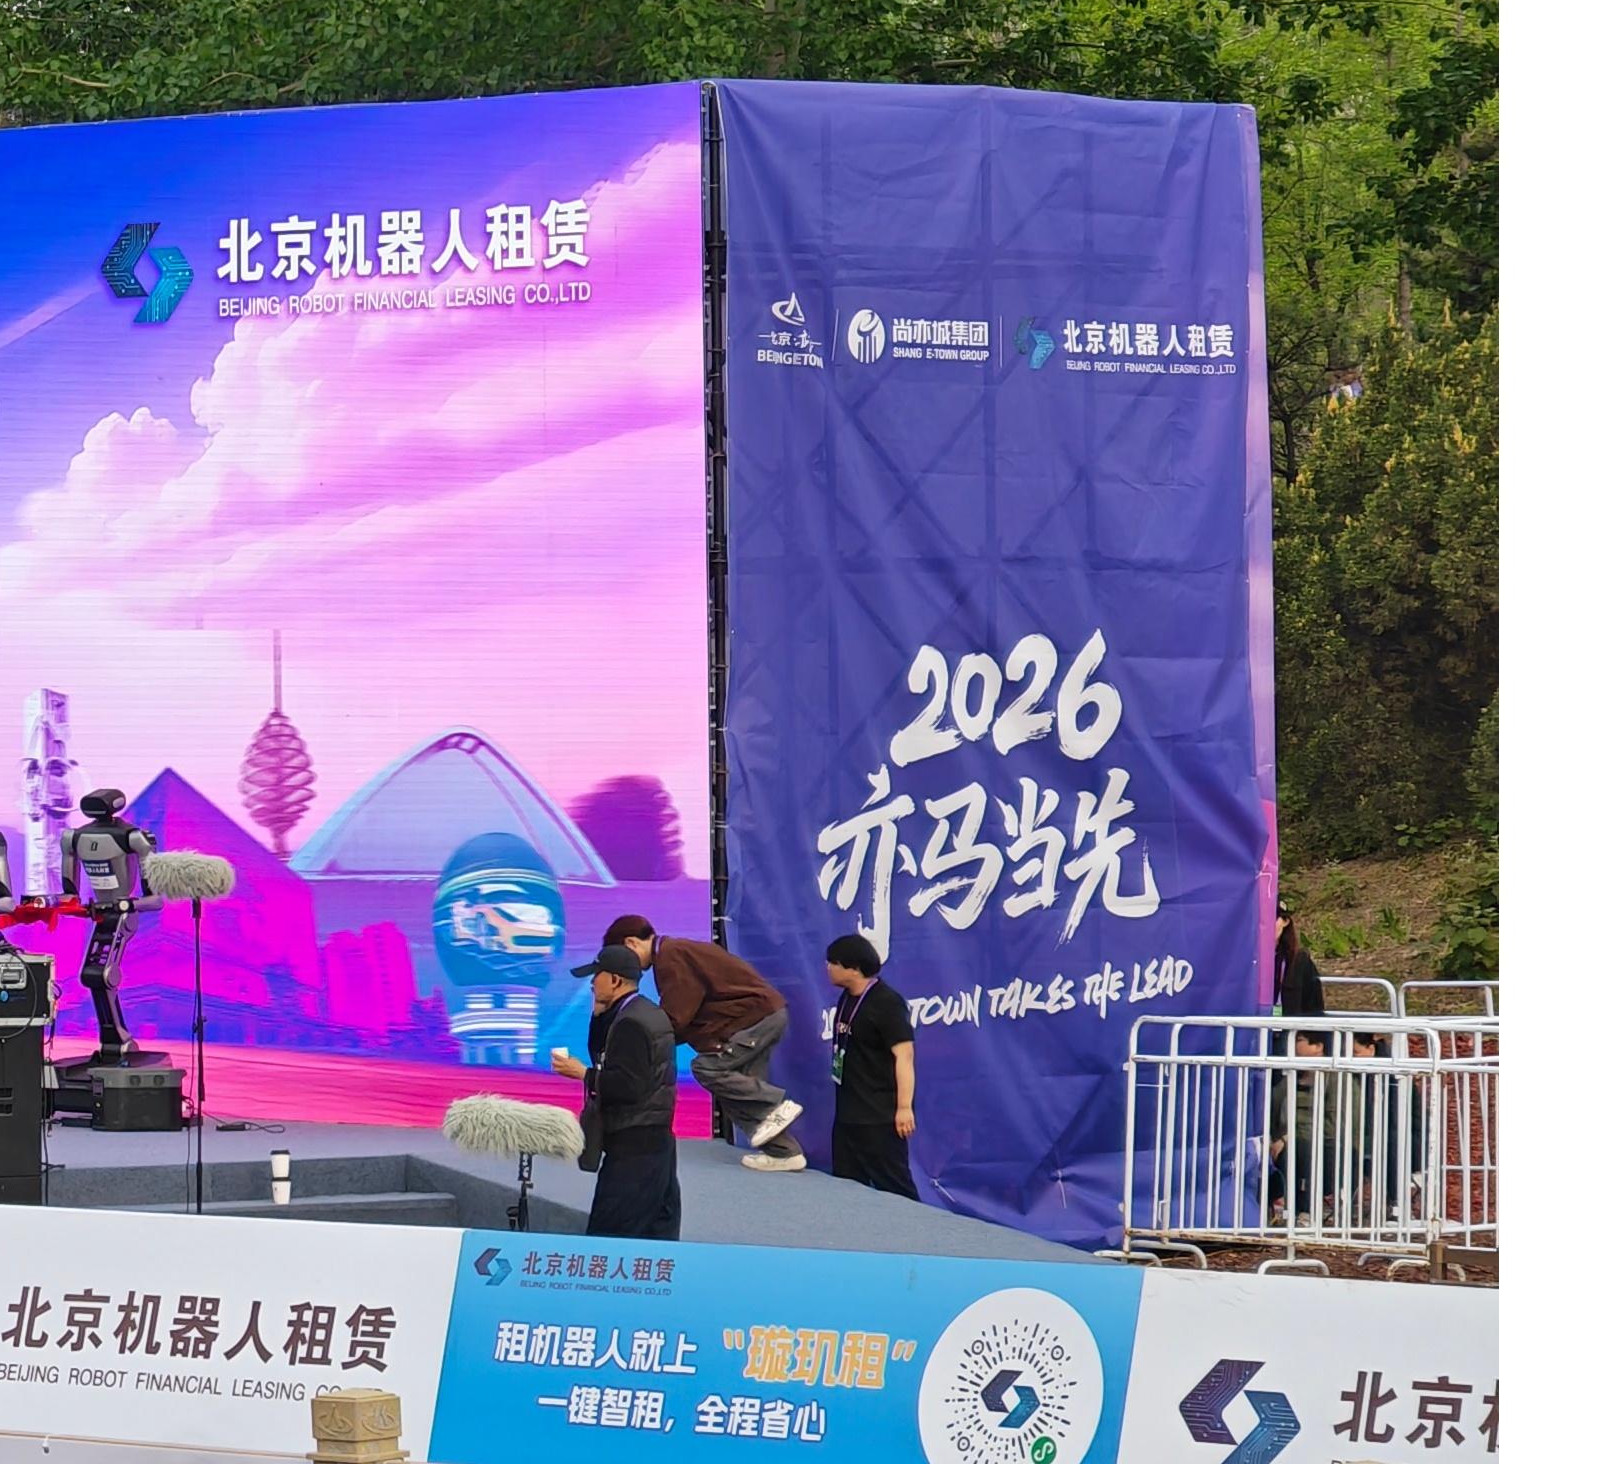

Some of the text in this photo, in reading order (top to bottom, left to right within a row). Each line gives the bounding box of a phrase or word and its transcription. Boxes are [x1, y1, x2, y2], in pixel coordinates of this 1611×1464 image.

[216, 199, 591, 284] 北京机器人租赁
[218, 298, 280, 318] BEIJING
[288, 294, 346, 315] ROBOT
[353, 290, 436, 312] FINANCIAL
[445, 285, 516, 308] LEASING
[893, 318, 990, 347] 尚亦城集团
[893, 346, 989, 361] SHANG E-TOWN GROUP
[1064, 319, 1234, 358] 北京机器人租赁
[891, 629, 1123, 766] 2026
[817, 764, 1161, 964] 亦马当先
[909, 954, 1194, 1028] TOWN TAKES THE LEAD
[522, 1251, 676, 1283] 北京机器人租赁
[0, 1284, 398, 1374] 北京机器人租赁
[493, 1320, 699, 1376] 租机器人就上
[67, 1367, 128, 1390] ROBOT
[135, 1371, 223, 1396] FINANCIAL
[232, 1377, 306, 1402] LEASING
